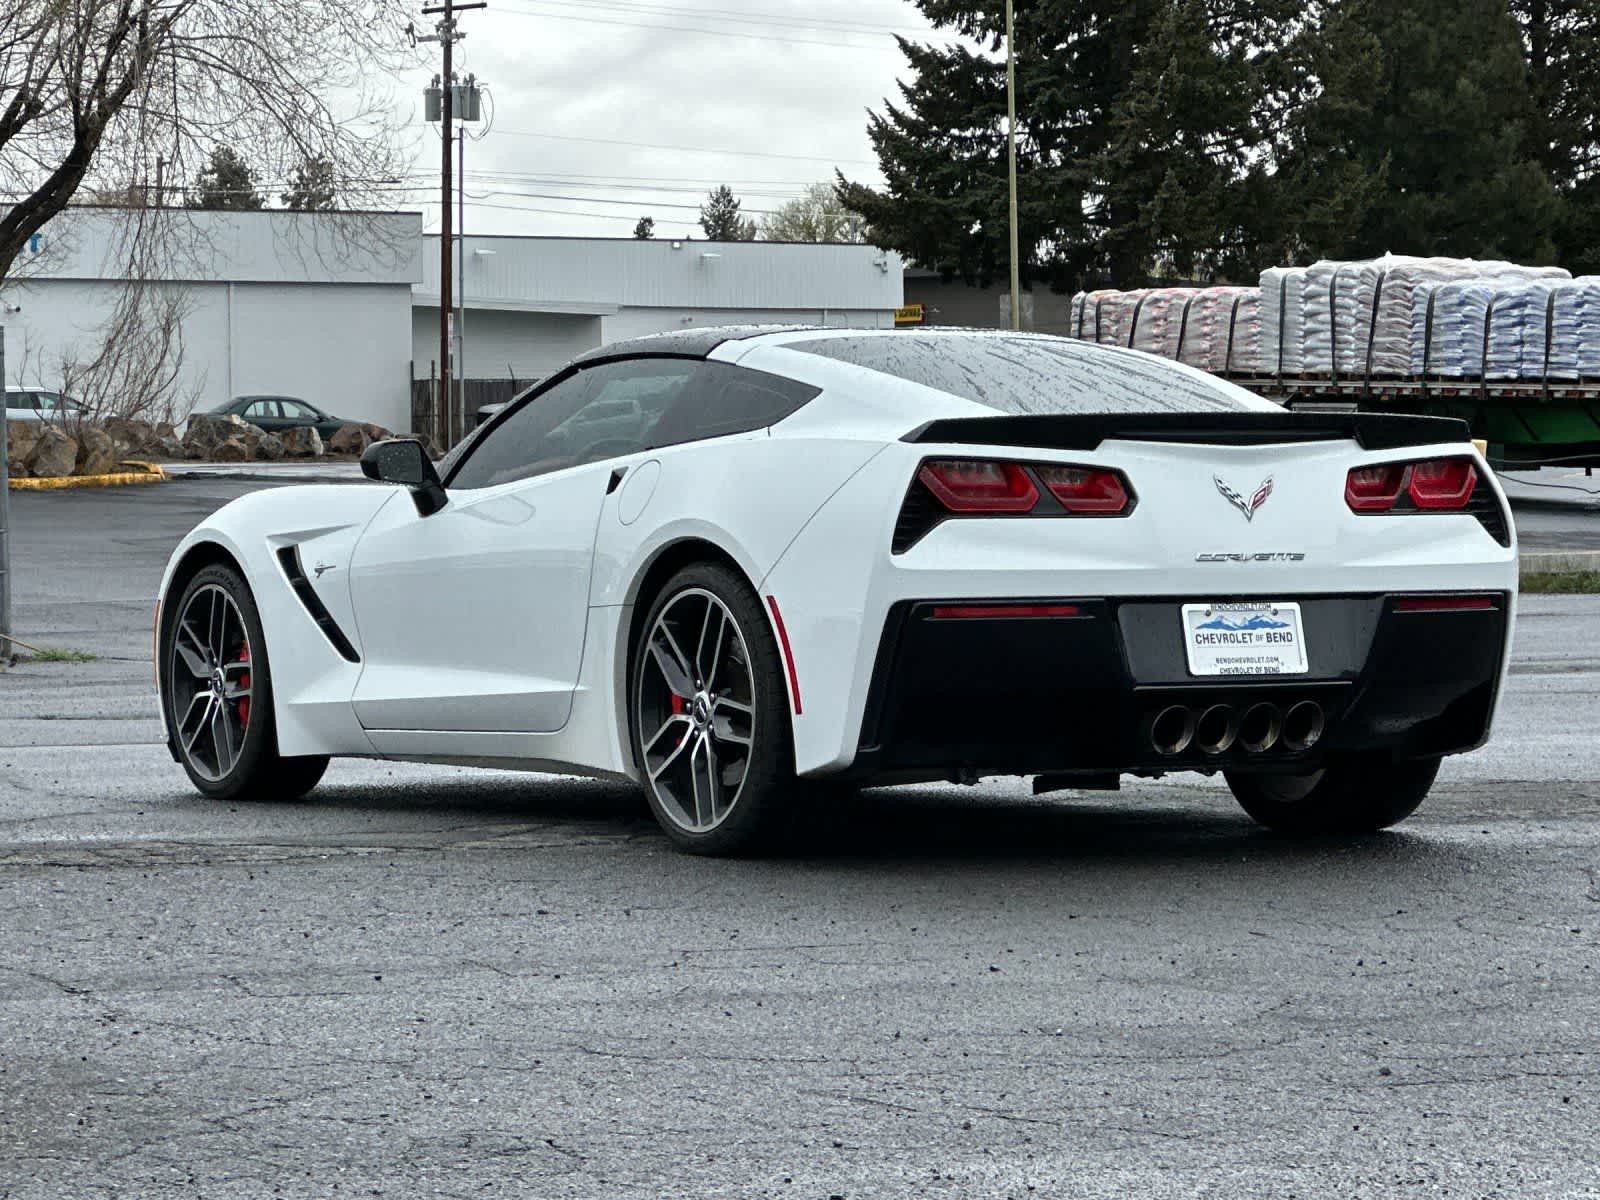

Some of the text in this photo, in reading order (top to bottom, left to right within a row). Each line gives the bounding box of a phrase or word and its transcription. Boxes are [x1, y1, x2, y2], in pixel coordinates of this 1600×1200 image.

[1195, 552, 1305, 562] CORVETTE
[1195, 632, 1293, 645] CHEVROLET OF BEND
[1215, 656, 1280, 665] BENDCHEVROLET.COM
[1219, 666, 1254, 674] CHEVROLET
[1264, 666, 1280, 674] BEND
